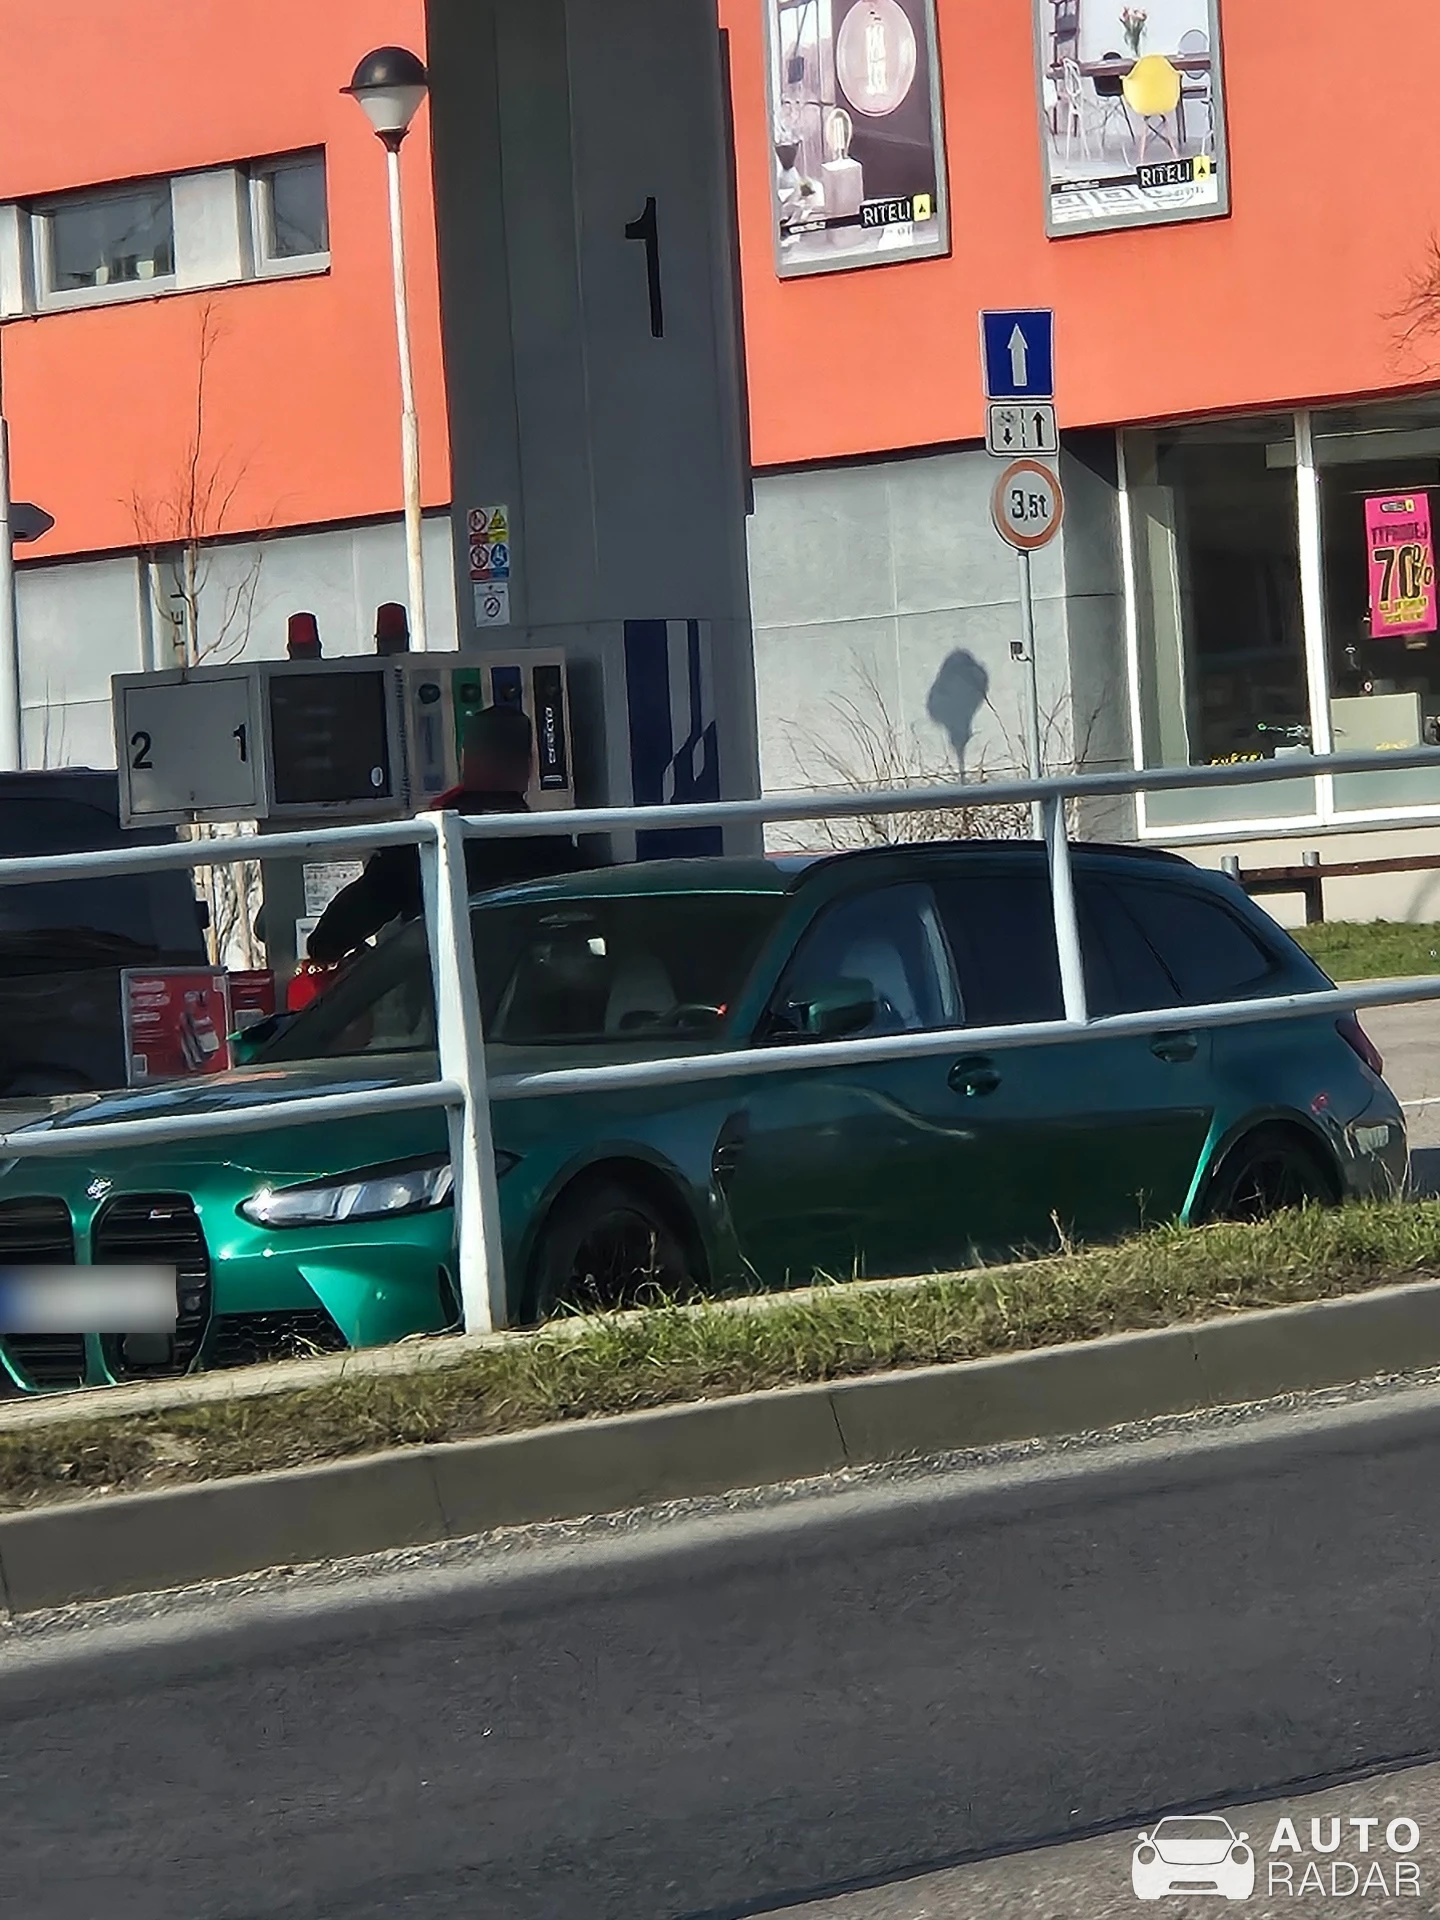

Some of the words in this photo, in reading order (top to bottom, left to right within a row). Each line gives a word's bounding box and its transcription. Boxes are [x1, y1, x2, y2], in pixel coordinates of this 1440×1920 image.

[1140, 160, 1191, 187] RITELI
[862, 200, 912, 226] RITELI
[624, 196, 663, 338] 1
[1011, 489, 1048, 521] 3,5t
[1373, 544, 1433, 602] 70%
[130, 731, 153, 770] 2
[233, 723, 247, 763] 1
